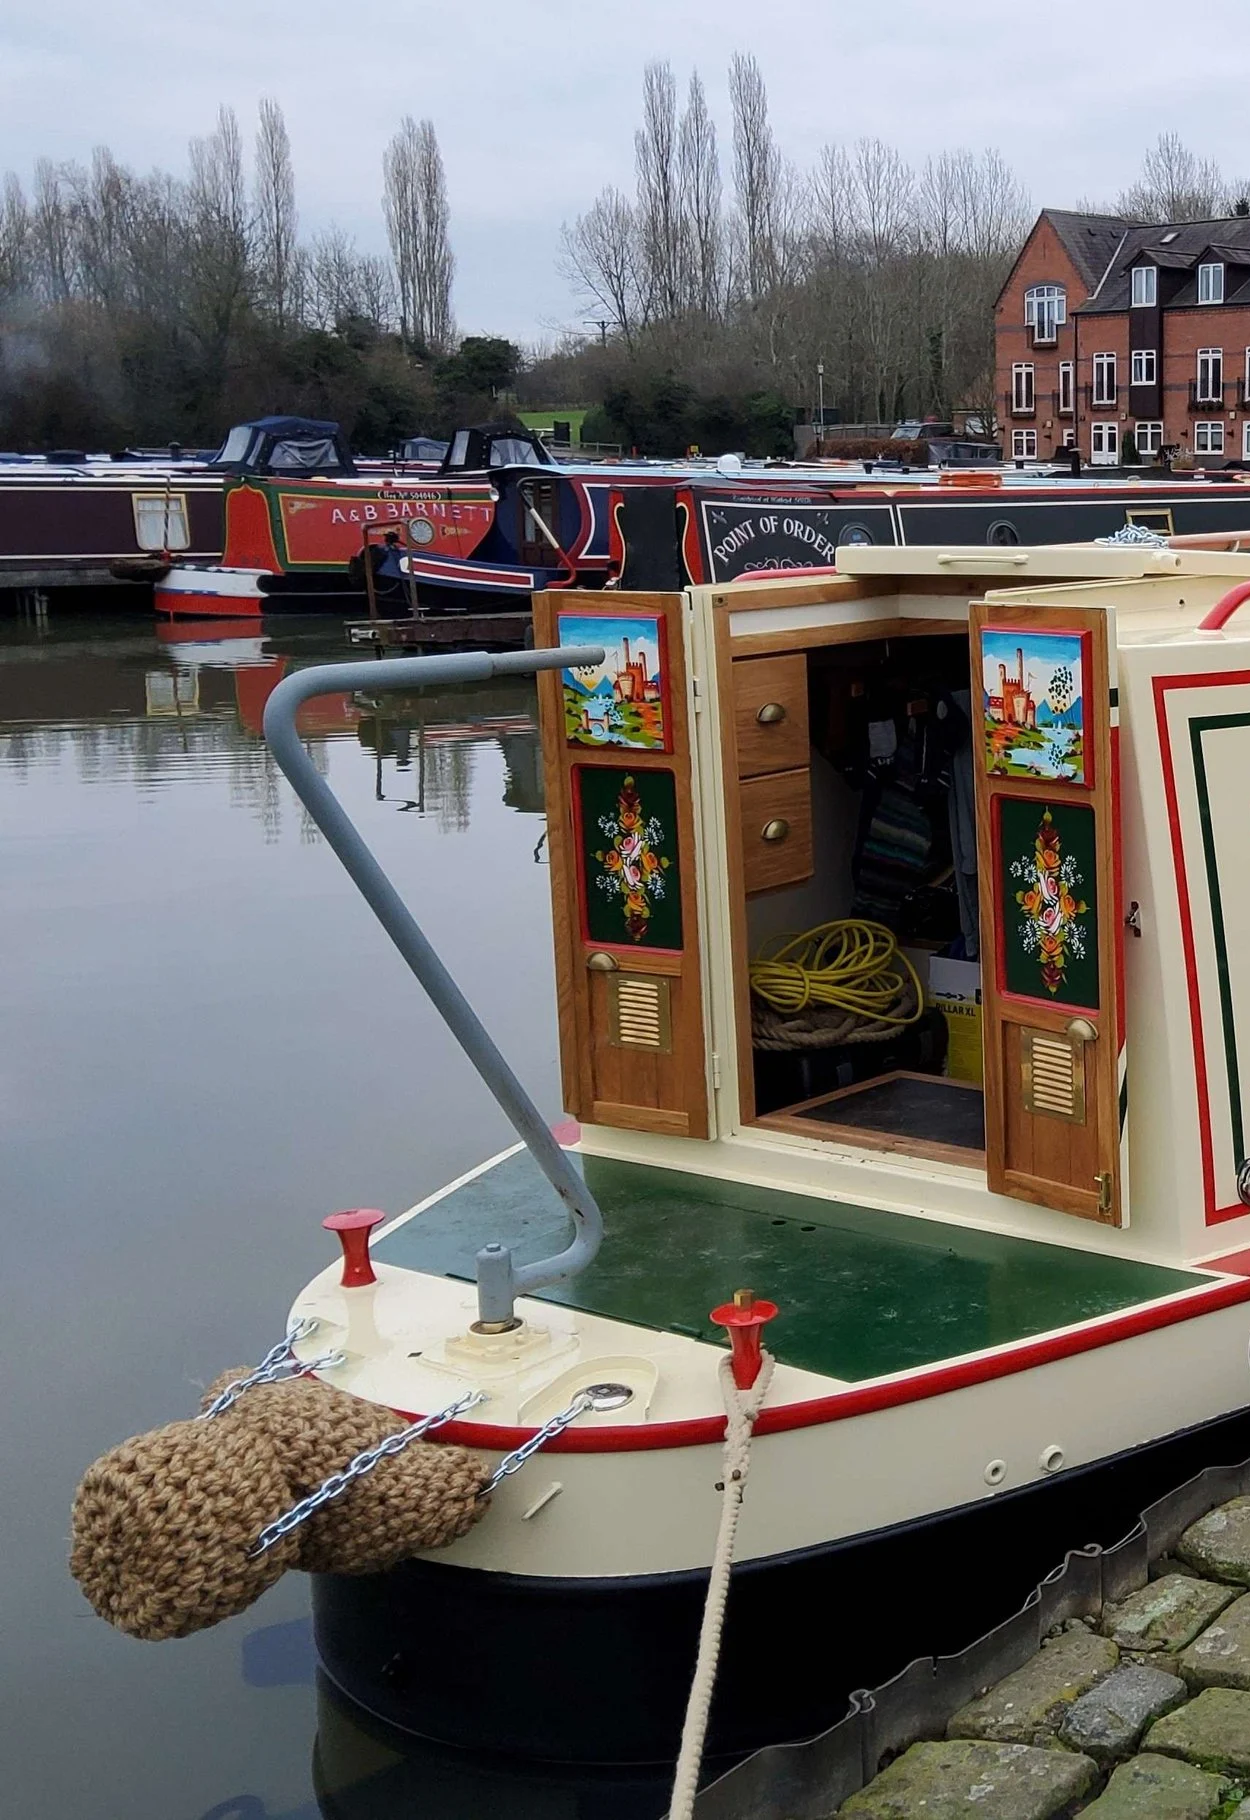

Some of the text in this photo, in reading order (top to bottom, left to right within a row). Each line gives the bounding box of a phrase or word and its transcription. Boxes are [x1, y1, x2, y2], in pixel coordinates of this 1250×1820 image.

[713, 515, 836, 563] POINT OF ORDER
[965, 1007, 976, 1017] XL
